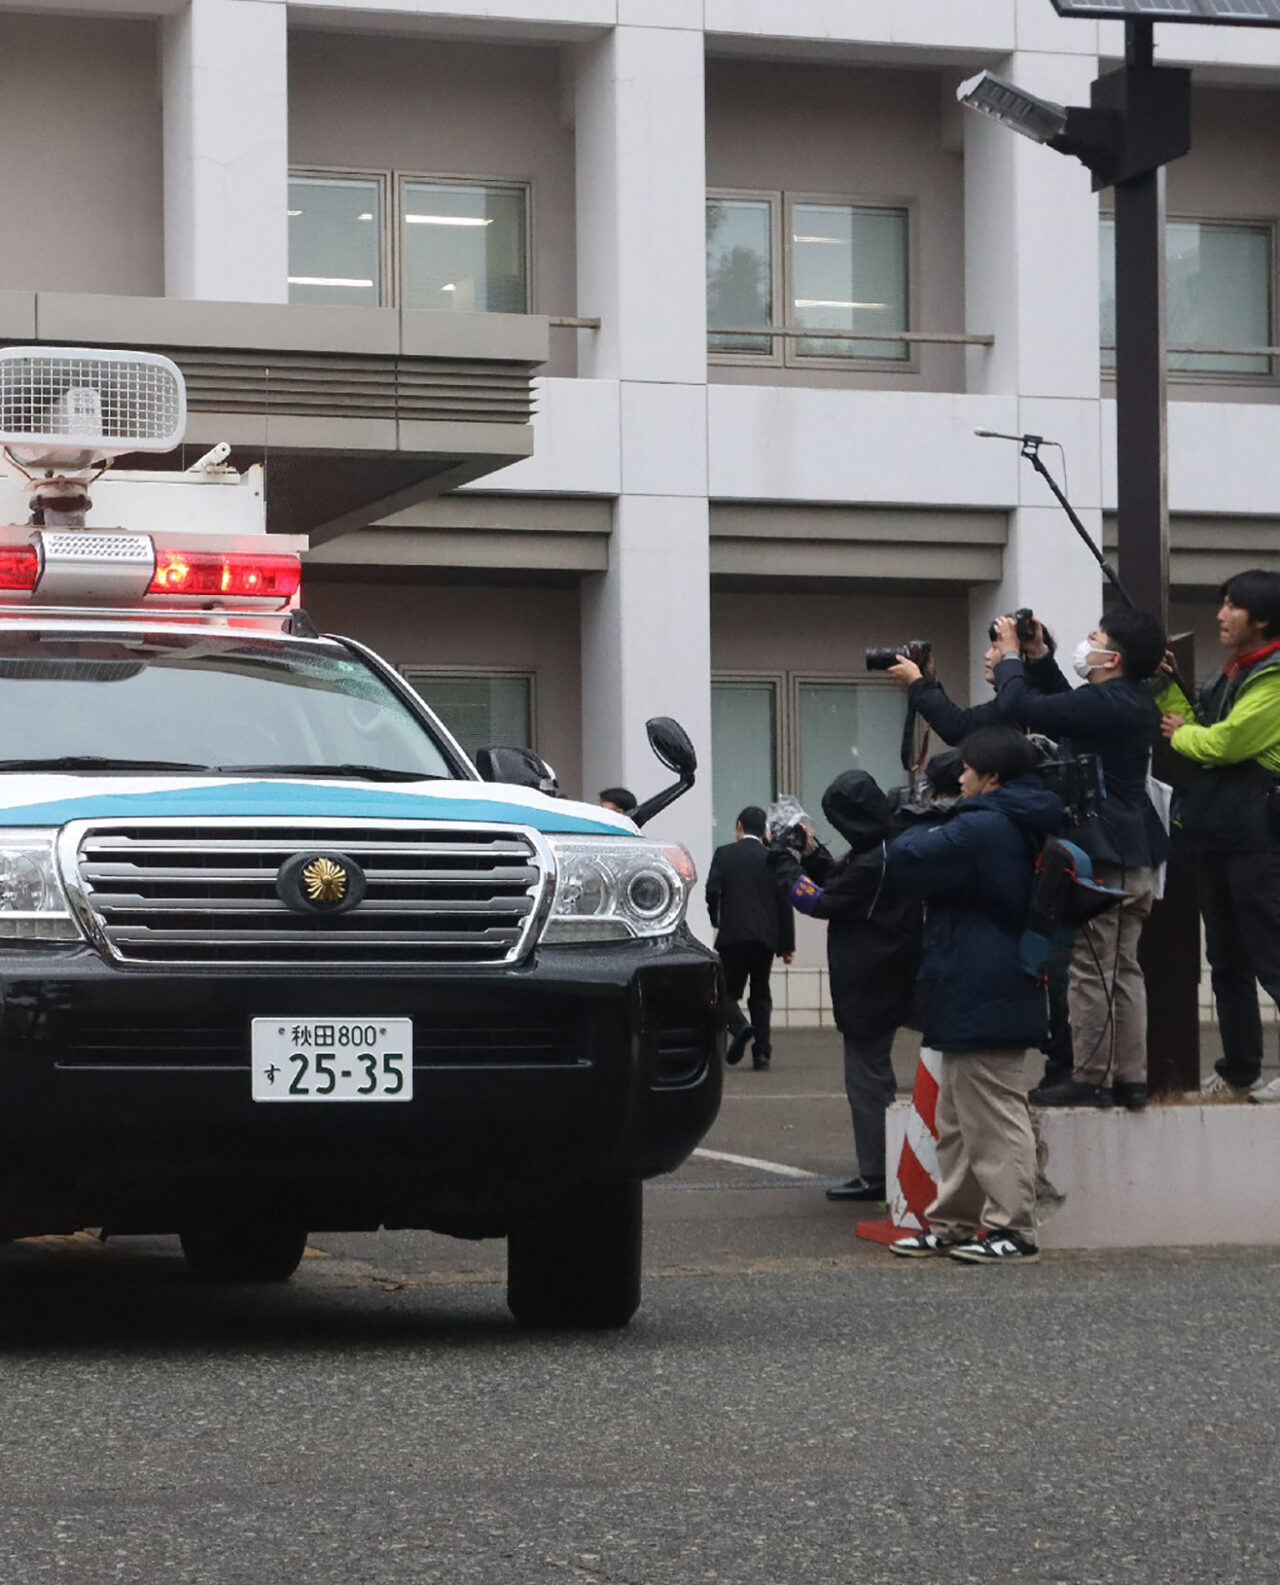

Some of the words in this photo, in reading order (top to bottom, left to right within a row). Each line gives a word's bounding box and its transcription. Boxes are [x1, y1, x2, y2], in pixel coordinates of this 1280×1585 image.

[291, 1025, 377, 1047] 秋田800
[264, 1063, 281, 1085] す
[288, 1053, 403, 1095] 25-35
